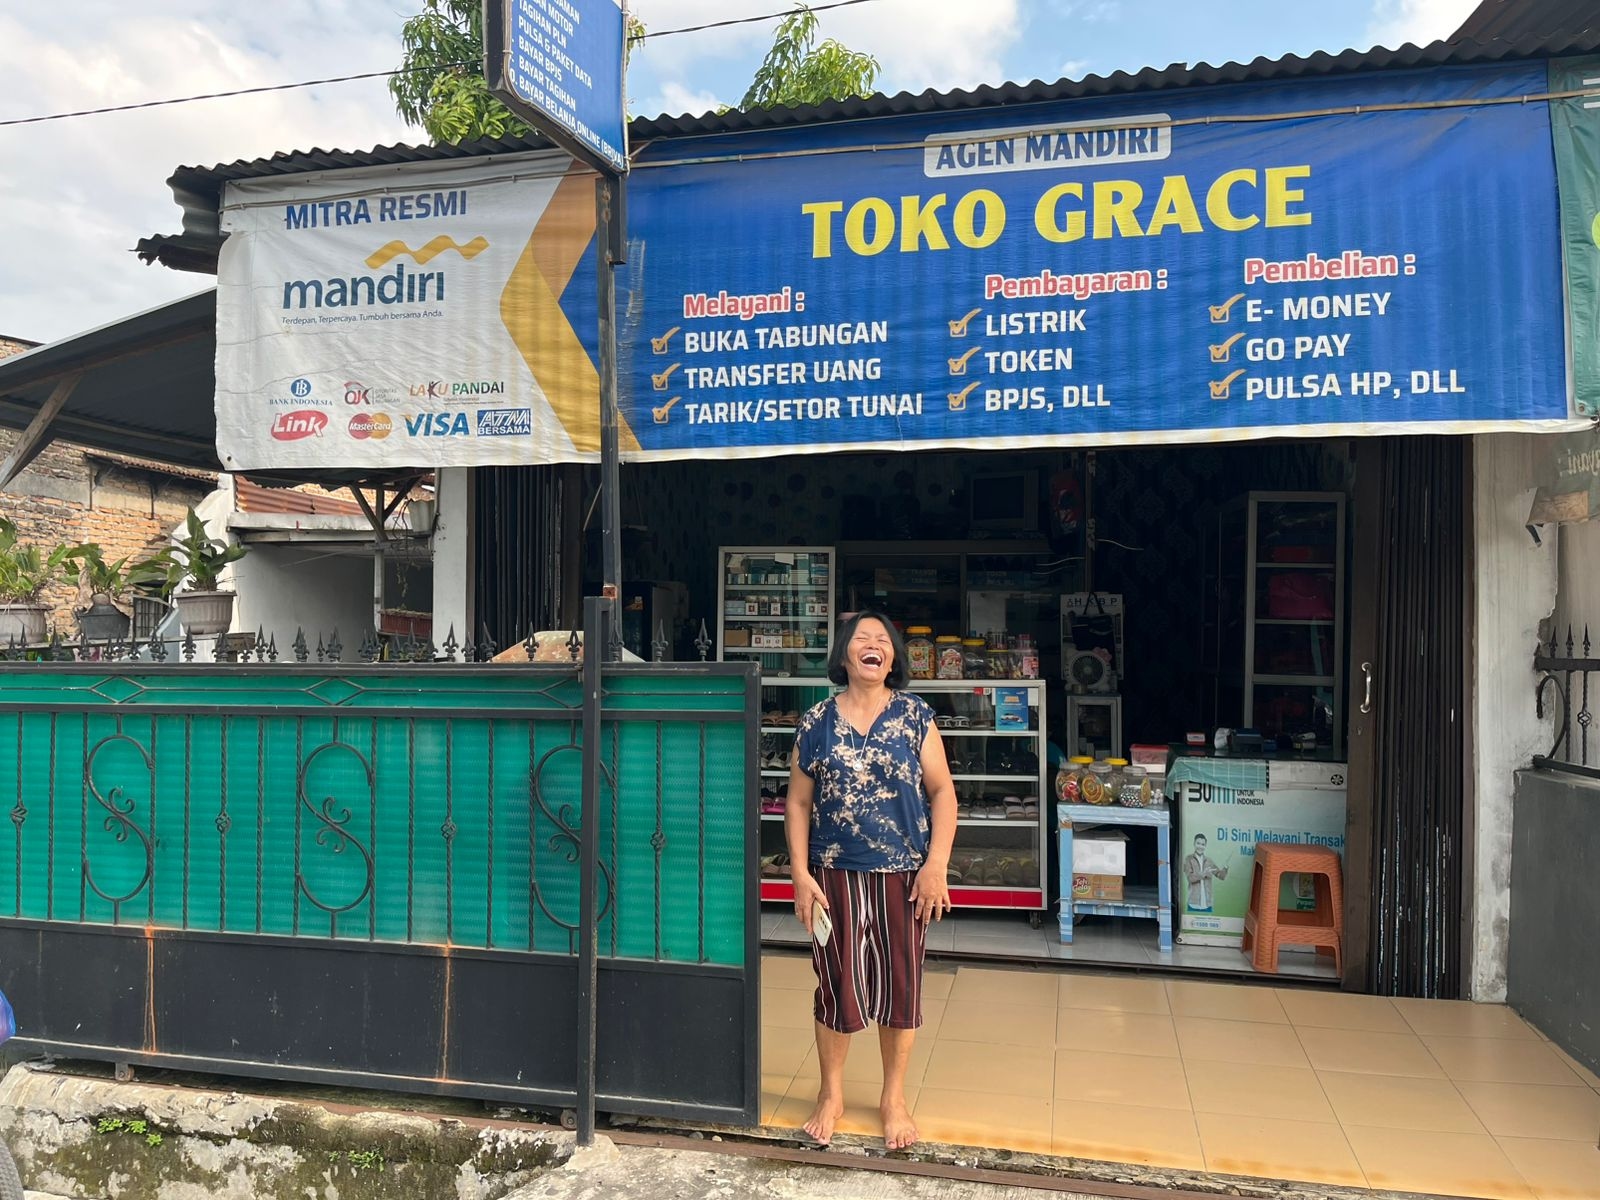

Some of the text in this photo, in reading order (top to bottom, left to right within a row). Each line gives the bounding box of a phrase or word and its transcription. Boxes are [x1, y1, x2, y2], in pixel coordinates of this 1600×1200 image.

[519, 0, 567, 49] TAGIHAN PLN
[547, 3, 574, 37] MOTOR
[518, 15, 593, 90] PULSA & PAKET DATA
[518, 34, 562, 82] BAYAR BPJS
[519, 54, 576, 112] BAYAR TAGIHAN
[519, 74, 545, 105] BAYAR
[545, 95, 576, 130] BELANJA
[577, 120, 601, 149] ONLINE
[936, 127, 1159, 170] AGEN MANDIRI
[286, 190, 467, 230] MITRA RESMI
[802, 165, 1313, 258] TOKO GRACE
[1244, 250, 1416, 285] Pembelian :
[283, 264, 444, 309] mandiri
[985, 269, 1168, 300] Pembayaran :
[359, 313, 390, 322] Tumbuh
[390, 311, 421, 320] bersama
[423, 309, 444, 317] Anda.
[683, 286, 804, 320] Melayani :
[1246, 292, 1392, 322] E- MONEY
[685, 321, 888, 354] BUKA TABUNGAN
[986, 309, 1087, 337] LISTRIK
[984, 348, 1073, 374] TOKEN
[1246, 333, 1351, 362] GO PAY
[684, 358, 881, 389] TRANSFER UANG
[1246, 369, 1466, 400] PULSA HP, DLL
[290, 398, 334, 406] INDONESIA
[409, 380, 504, 399] LAKU PANDAI
[985, 384, 1111, 413] BPJS, DLL
[403, 411, 470, 437] VISA
[479, 409, 530, 427] ATM
[685, 393, 922, 424] TARIK/SETOR TUNAI
[273, 412, 324, 438] Link
[349, 422, 391, 432] MasterCard
[478, 426, 530, 435] BERSAMA
[1236, 798, 1265, 806] INDONESIA
[1217, 828, 1228, 841] Di
[1231, 828, 1251, 842] Sini
